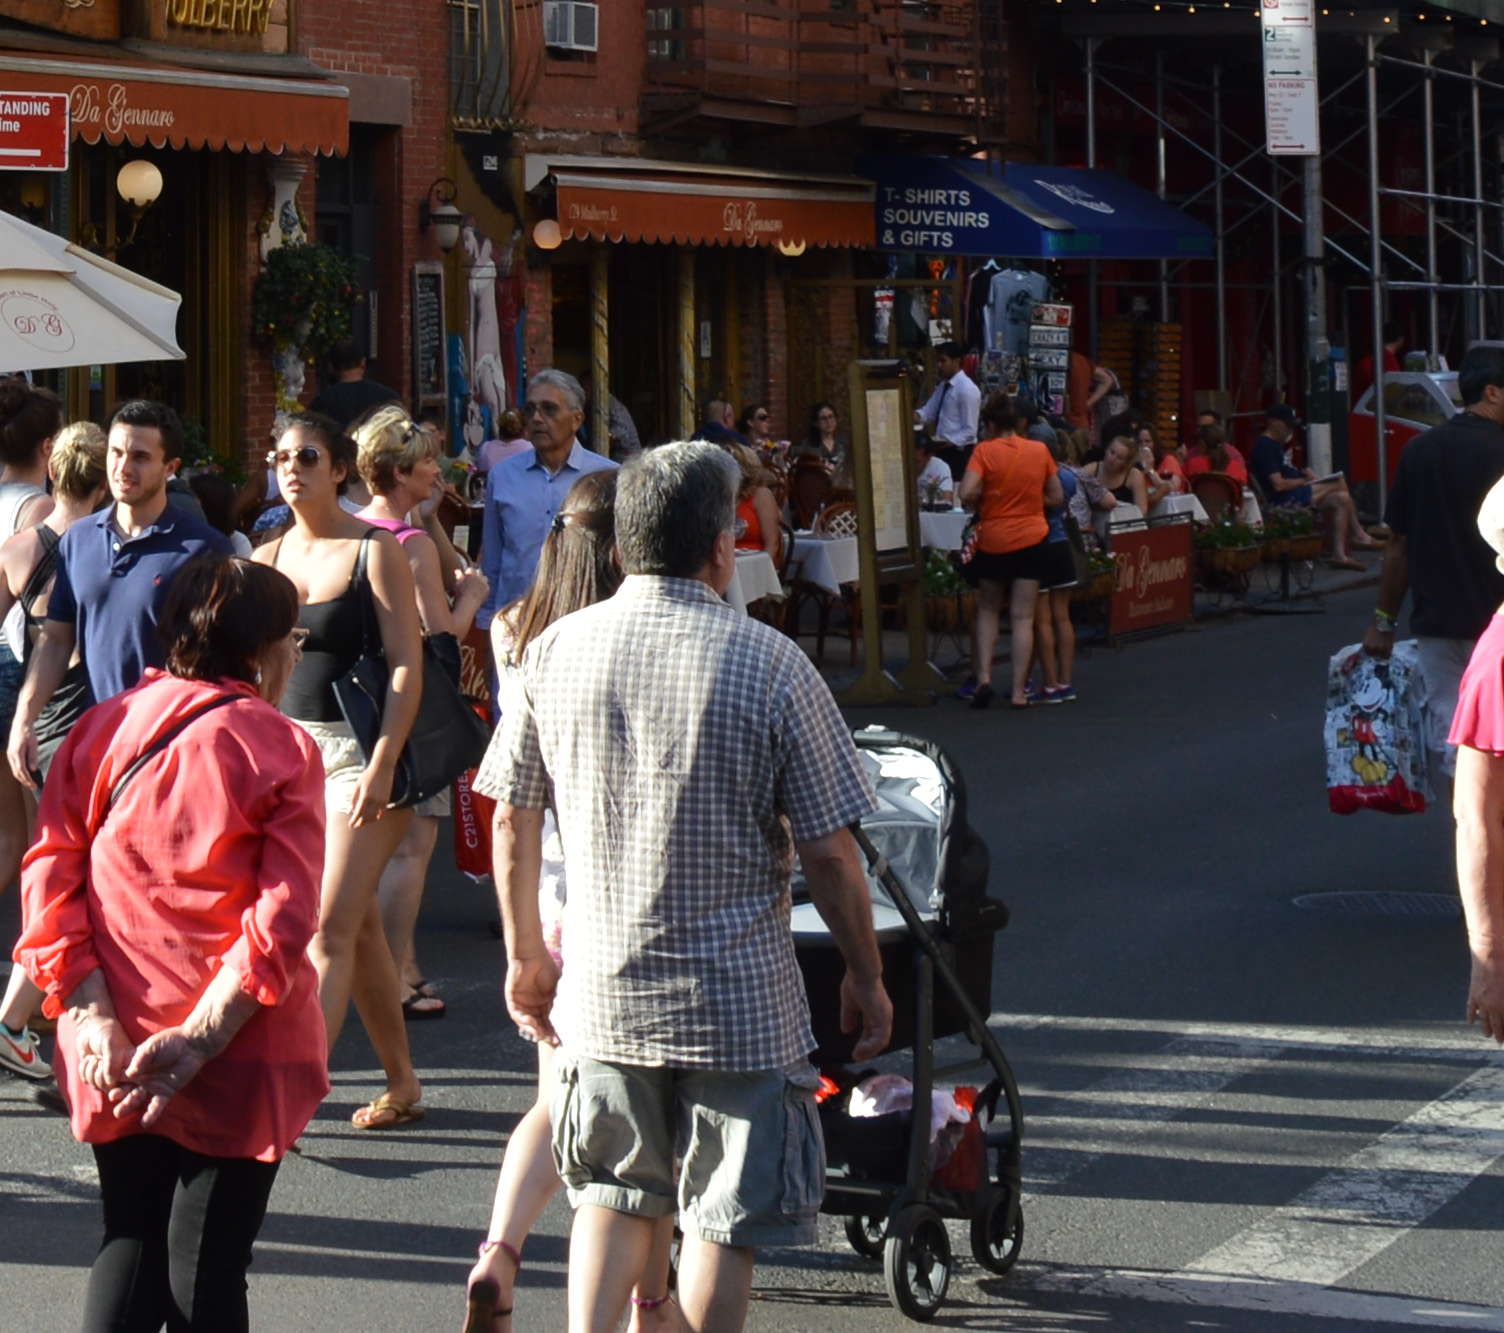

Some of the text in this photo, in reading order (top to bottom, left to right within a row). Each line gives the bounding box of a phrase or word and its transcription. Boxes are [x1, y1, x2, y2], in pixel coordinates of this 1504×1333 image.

[69, 83, 176, 135] Da Gennaro
[903, 188, 972, 209] SHIRTS
[882, 207, 991, 230] SOUVENIRS
[882, 229, 954, 248] & GIFTS
